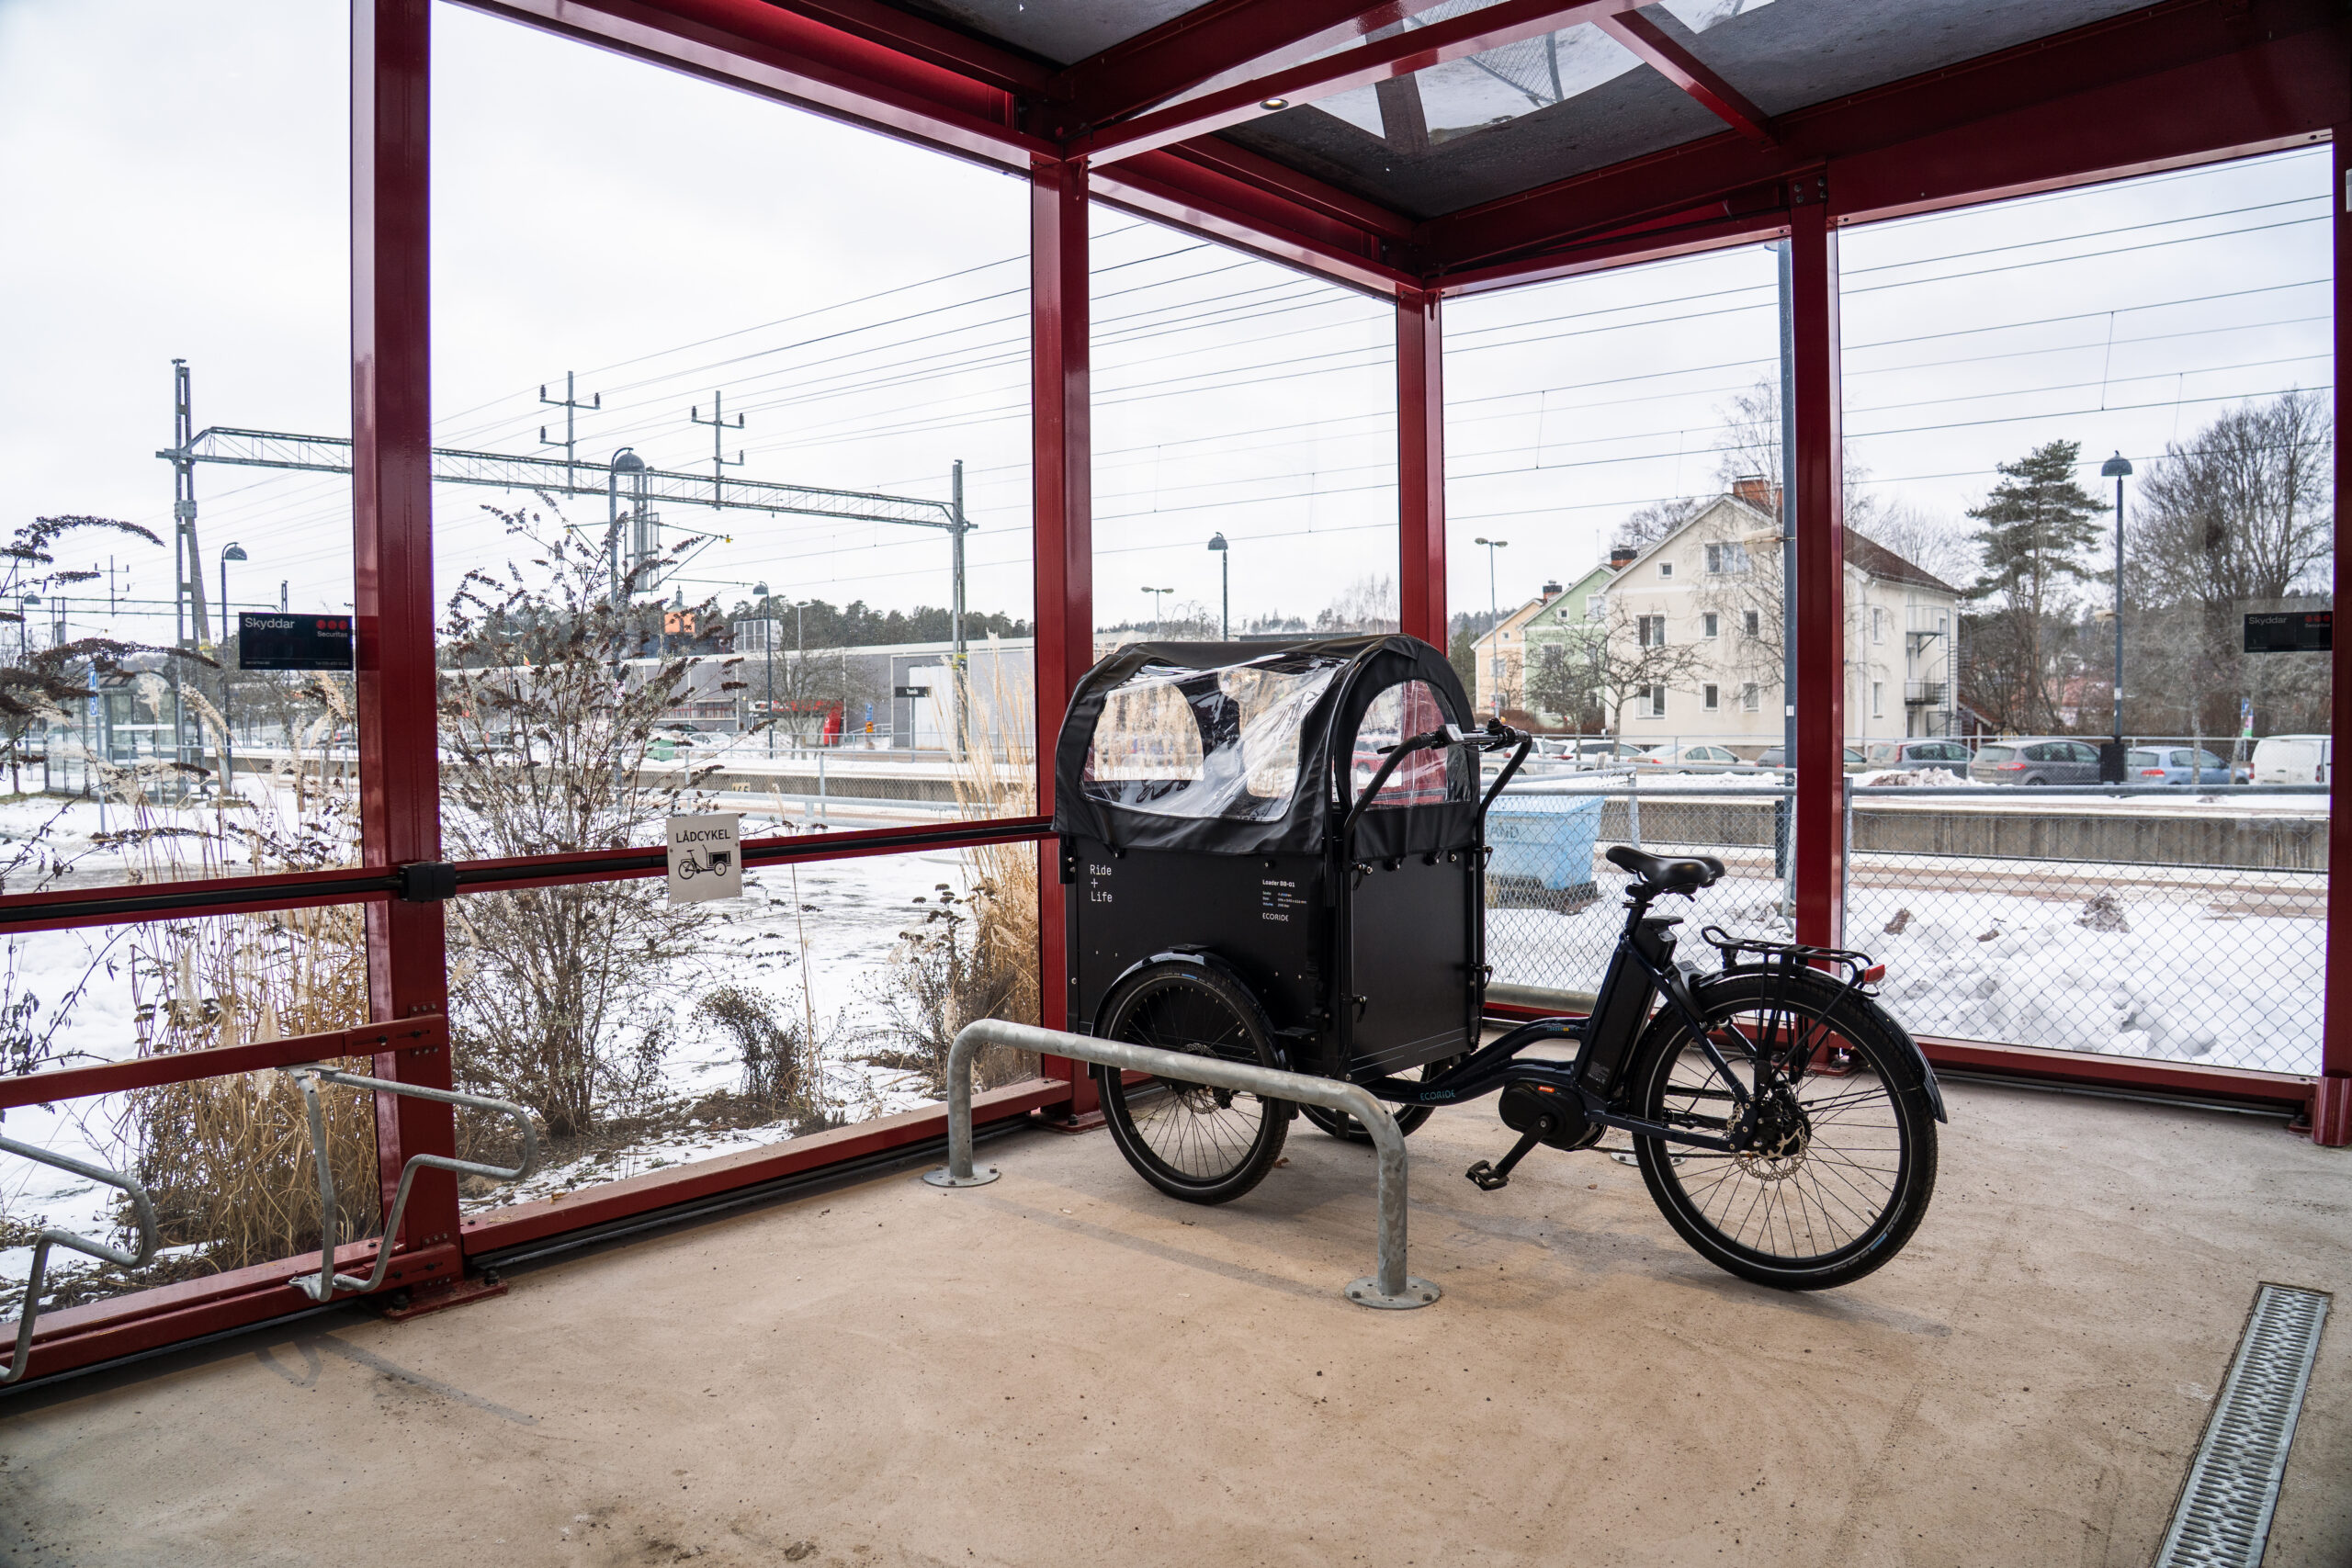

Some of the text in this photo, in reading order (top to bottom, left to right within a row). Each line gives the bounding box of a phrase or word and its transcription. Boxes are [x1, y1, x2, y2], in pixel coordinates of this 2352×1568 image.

[244, 616, 295, 630] Skyddar
[2248, 616, 2288, 626] Skyddar
[675, 829, 731, 843] LÅDCYKEL
[1090, 863, 1112, 875] Ride
[1091, 891, 1113, 903] Life
[1262, 912, 1289, 922] ECORIDE
[1419, 1089, 1456, 1101] ECORIDE
